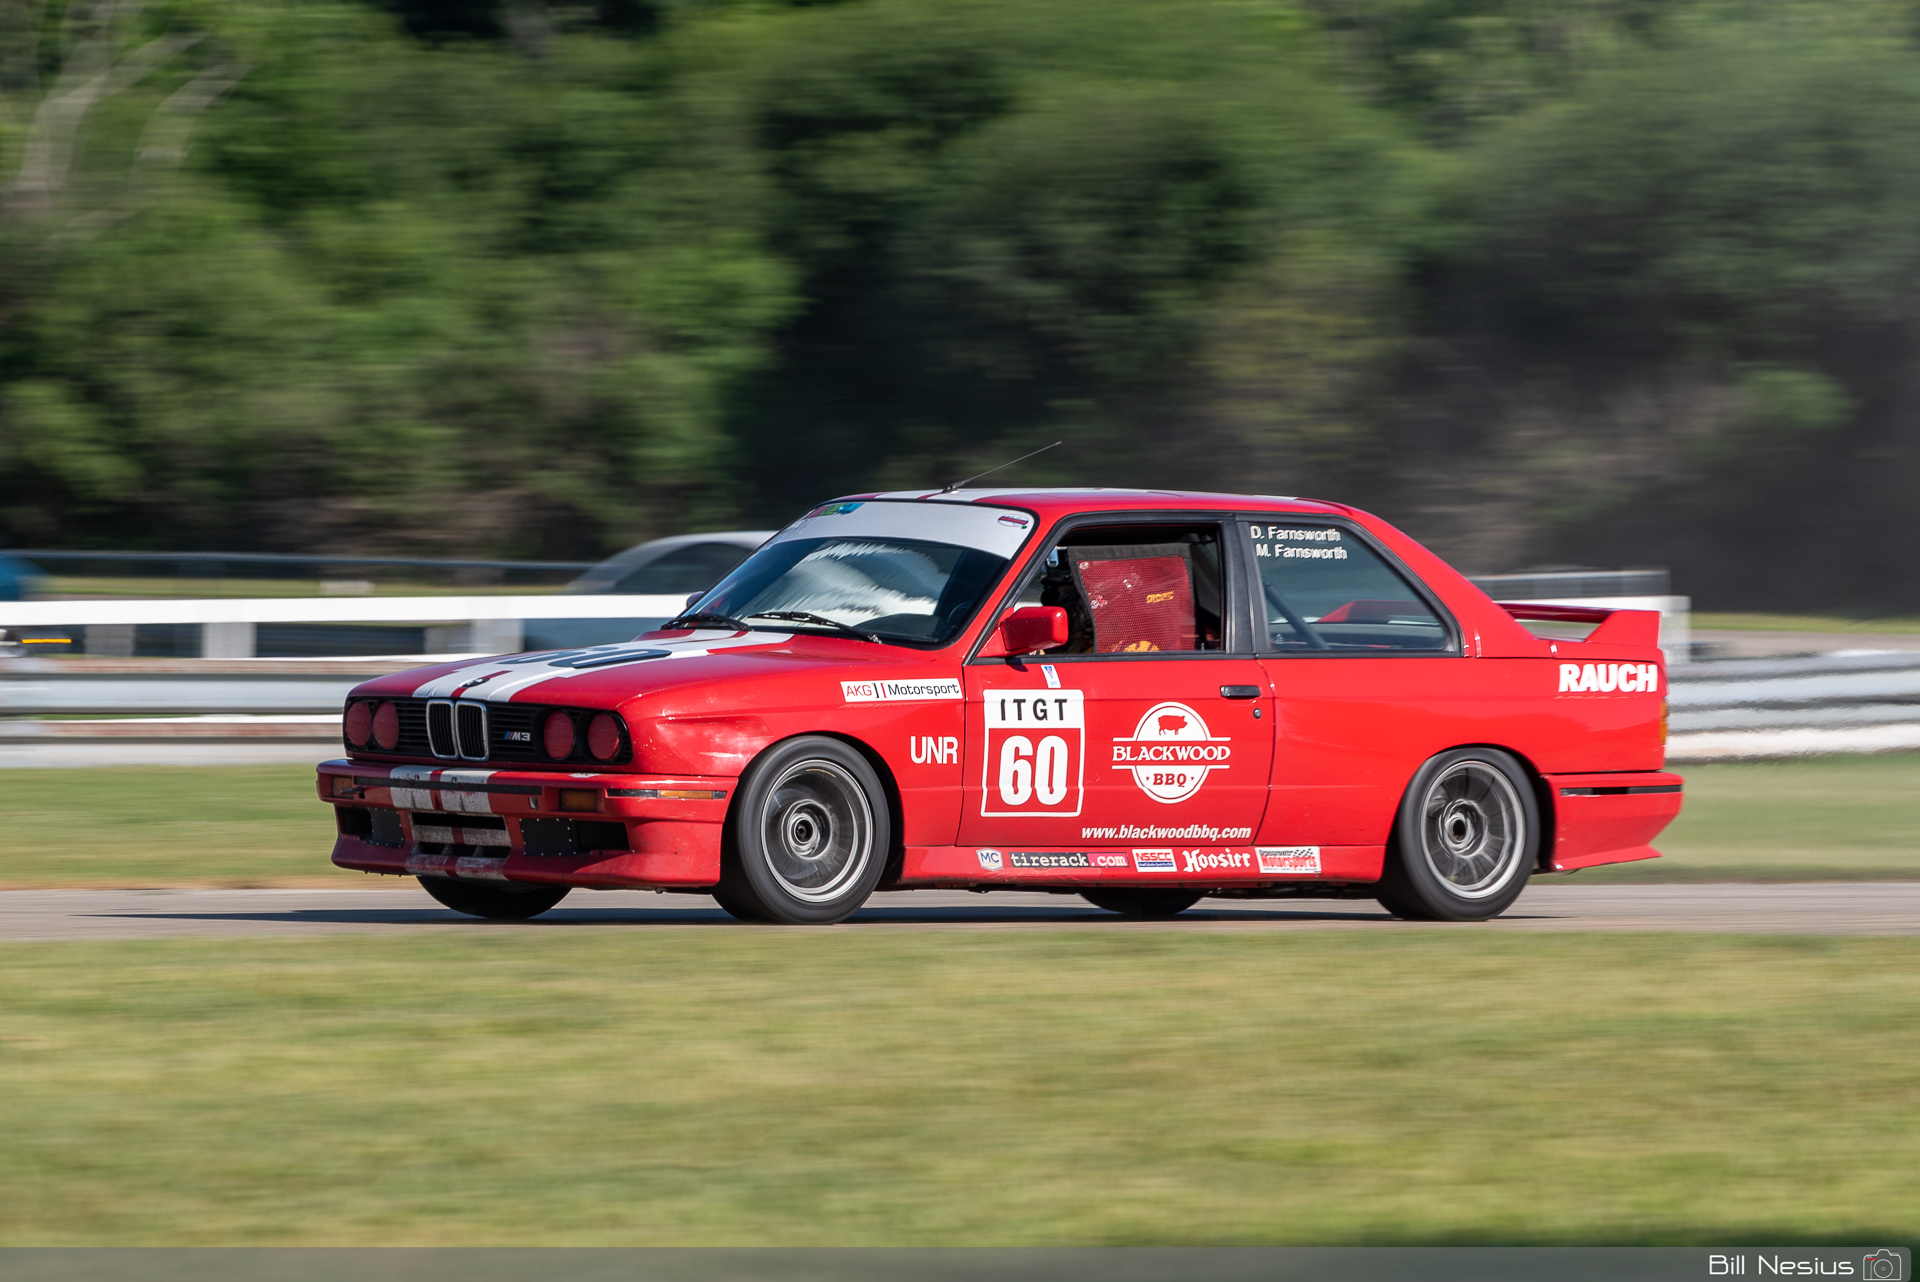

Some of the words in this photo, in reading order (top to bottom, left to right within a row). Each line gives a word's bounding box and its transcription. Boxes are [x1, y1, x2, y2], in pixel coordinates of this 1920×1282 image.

[1250, 526, 1265, 540] D.
[1267, 526, 1342, 542] Farnsworth
[1255, 543, 1272, 557] M.
[1274, 543, 1348, 560] Farnsworth
[1557, 663, 1658, 693] RAUCH
[846, 685, 872, 697] AKG
[887, 683, 960, 697] Motorsport
[1000, 698, 1068, 721] ITGT
[511, 731, 531, 741] M3
[910, 735, 959, 765] UNR
[1112, 745, 1231, 762] BLACKWOOD
[998, 735, 1069, 806] 60
[1152, 773, 1187, 788] BBQ
[1081, 824, 1252, 841] www.blackwoodbbq.com
[980, 852, 1000, 864] MC
[1010, 852, 1128, 868] tirerack.com
[1135, 852, 1172, 862] NSSCC
[1182, 847, 1251, 873] Hoosier
